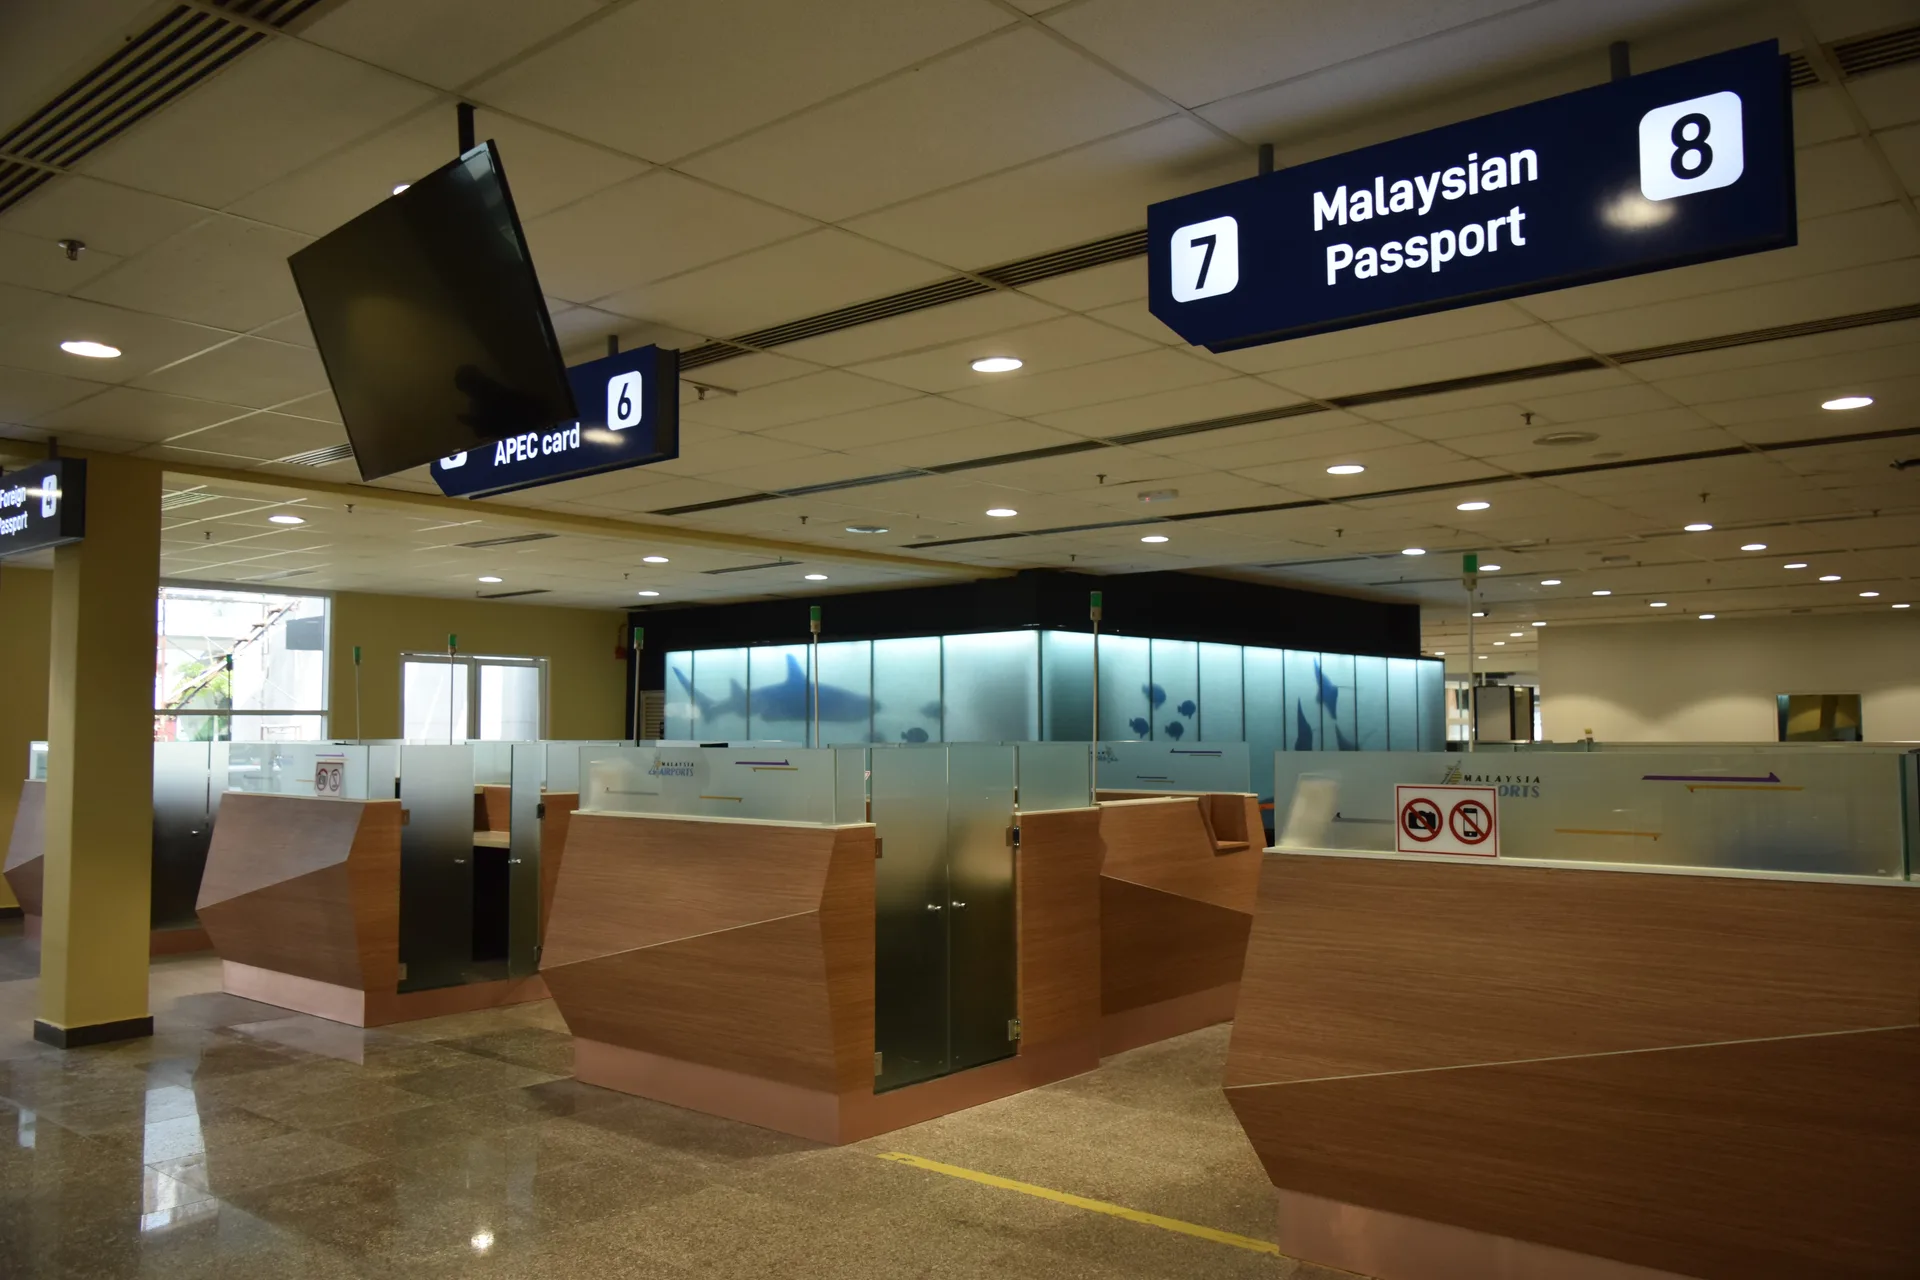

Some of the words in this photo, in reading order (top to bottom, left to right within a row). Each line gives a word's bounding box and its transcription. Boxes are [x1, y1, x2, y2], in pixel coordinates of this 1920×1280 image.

[1669, 112, 1714, 180] 8
[1313, 148, 1539, 231] Malaysian
[1190, 234, 1218, 290] 7
[1326, 205, 1526, 285] Passport
[617, 382, 632, 421] 6
[494, 432, 538, 466] APEC
[542, 421, 580, 455] card
[0, 510, 28, 536] assport
[1464, 774, 1540, 784] MALAYSIA
